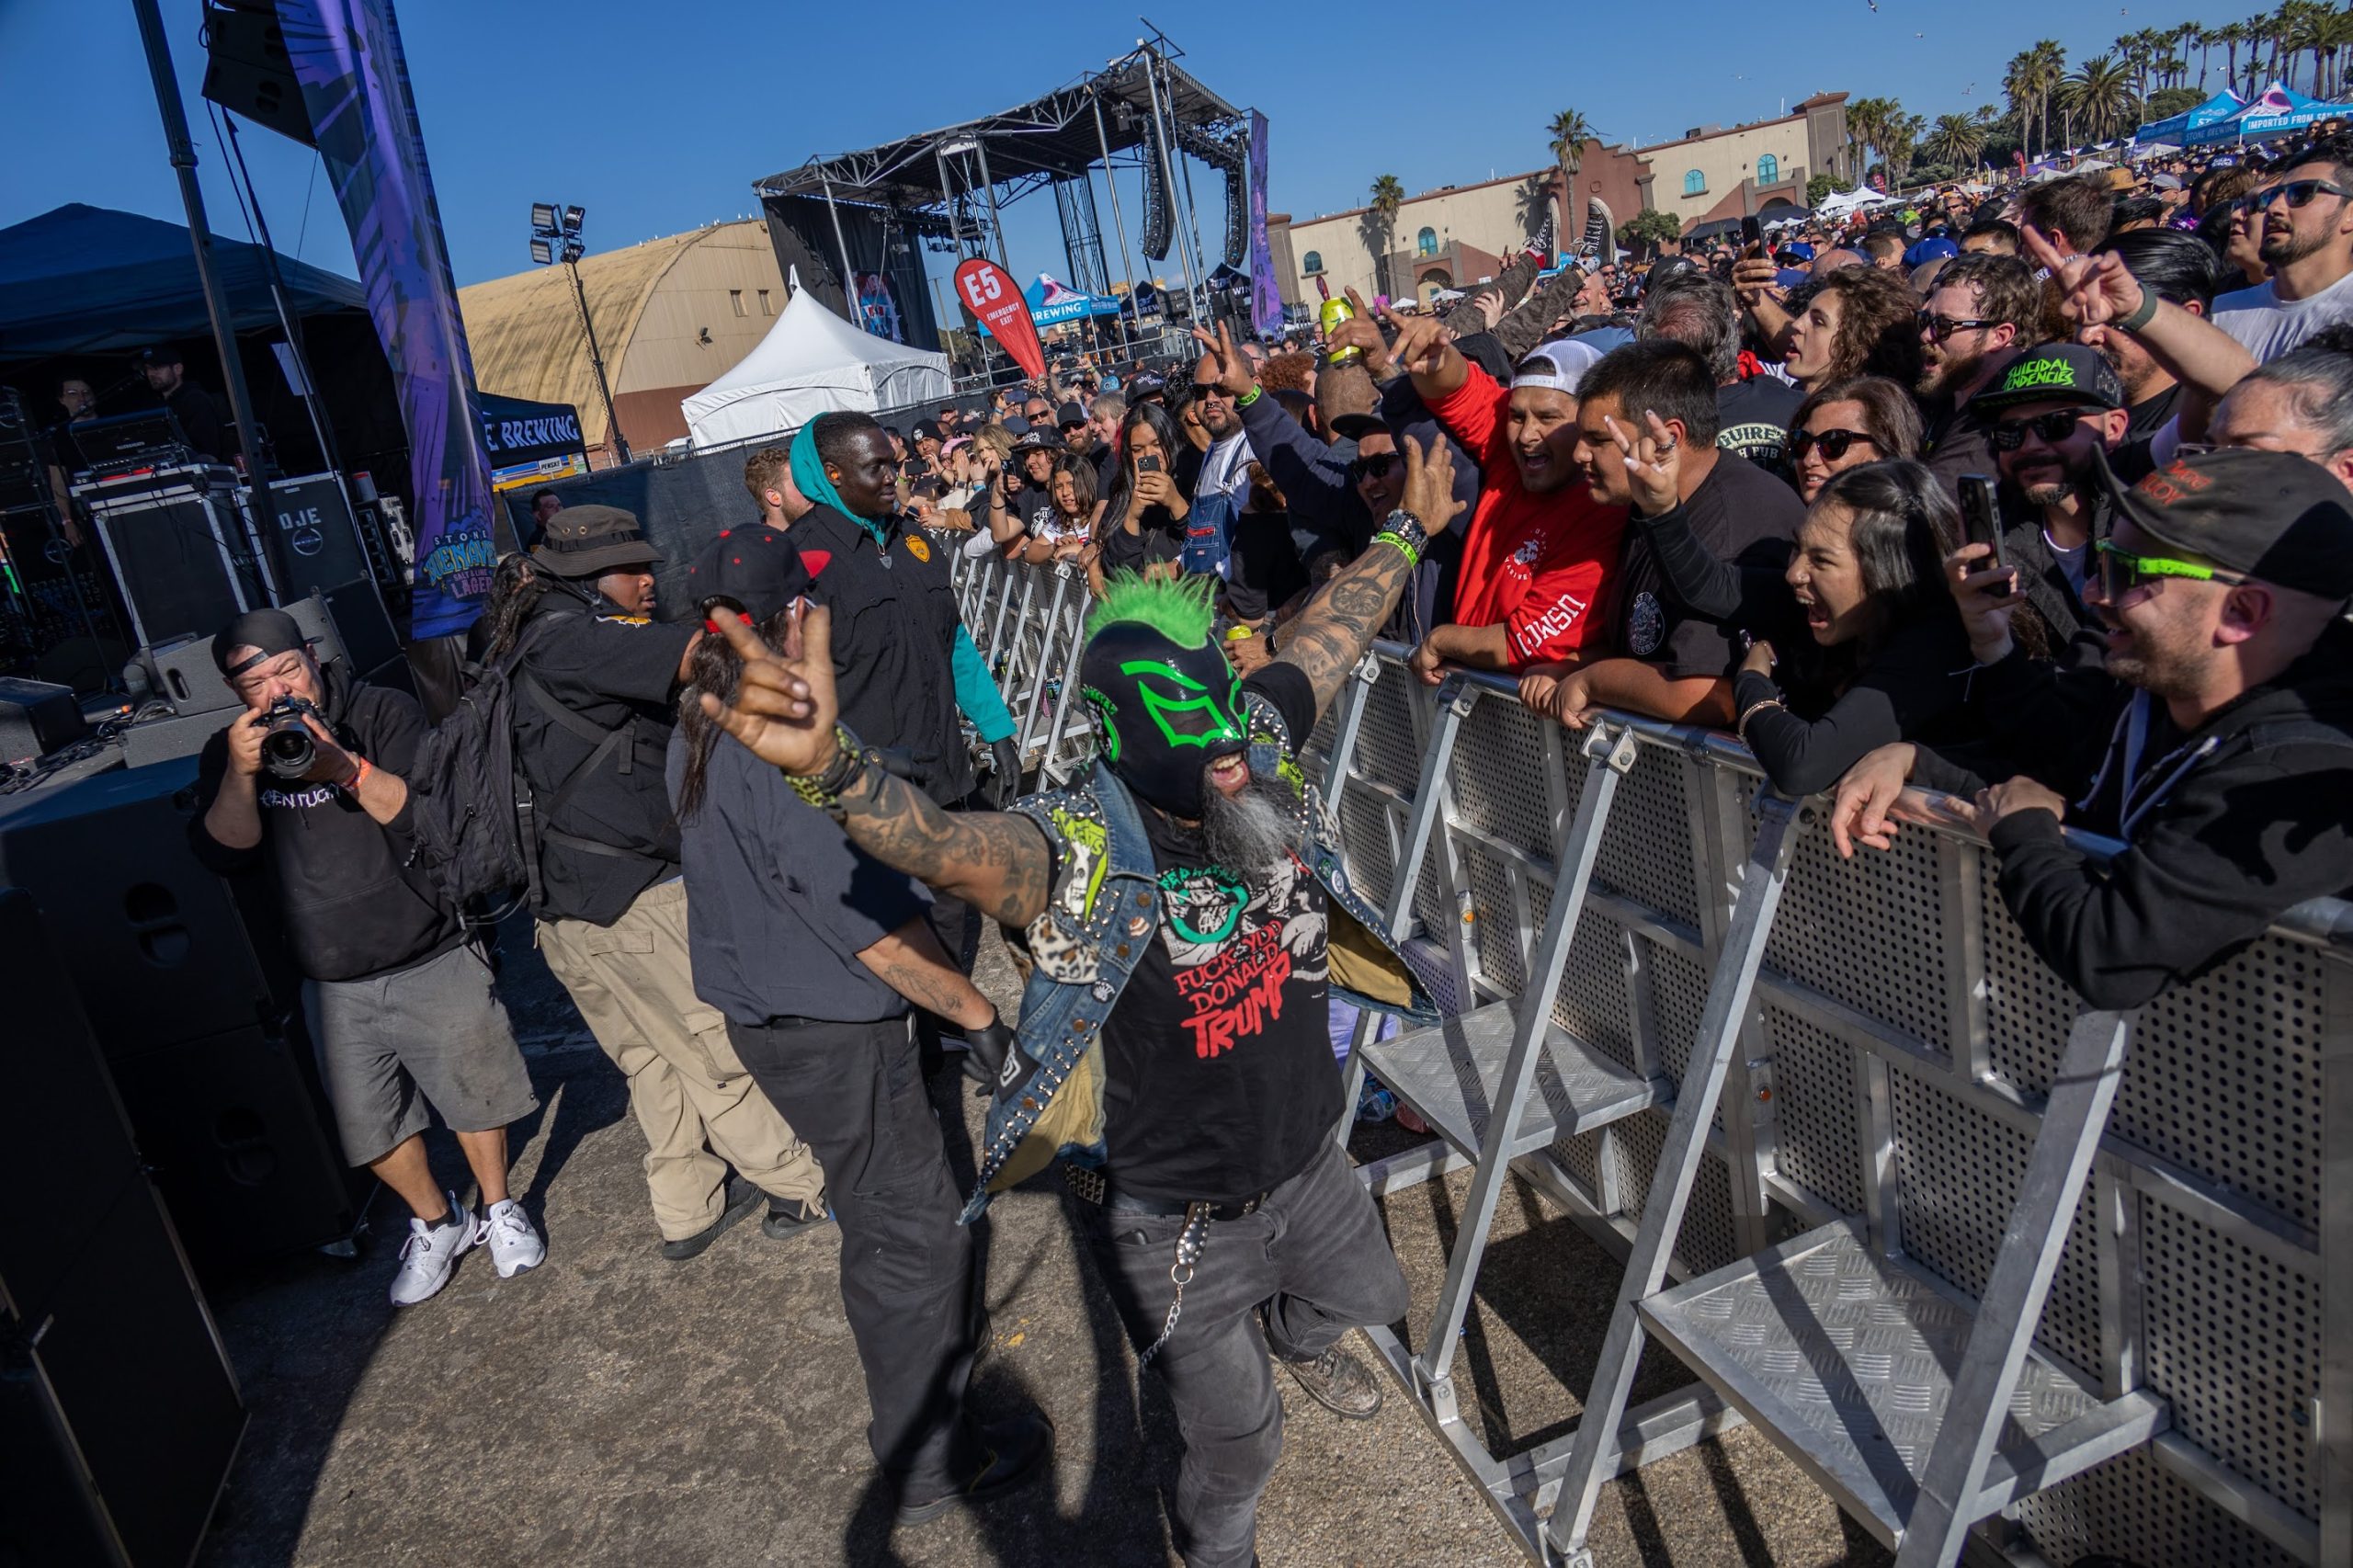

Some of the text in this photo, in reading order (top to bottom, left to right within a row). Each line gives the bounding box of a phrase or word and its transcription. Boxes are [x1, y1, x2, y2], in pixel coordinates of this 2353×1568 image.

[2186, 131, 2205, 142] STONE
[2207, 121, 2236, 138] BREWING
[2247, 117, 2289, 131] IMPORTED
[2291, 113, 2314, 126] FROM
[962, 266, 1002, 308] E5
[986, 301, 1020, 322] EMERGENCY
[999, 315, 1013, 326] EXIT
[2007, 358, 2075, 378] SUICIDAL
[2002, 369, 2075, 392] TENDENCIES
[500, 415, 580, 449] BREWING
[1752, 447, 1779, 459] PUB
[540, 460, 561, 471] PENSKE
[434, 530, 487, 546] STONE
[1173, 947, 1238, 995] FUCK
[1188, 942, 1279, 1014] DONALD
[1180, 950, 1290, 1059] TRUMP
